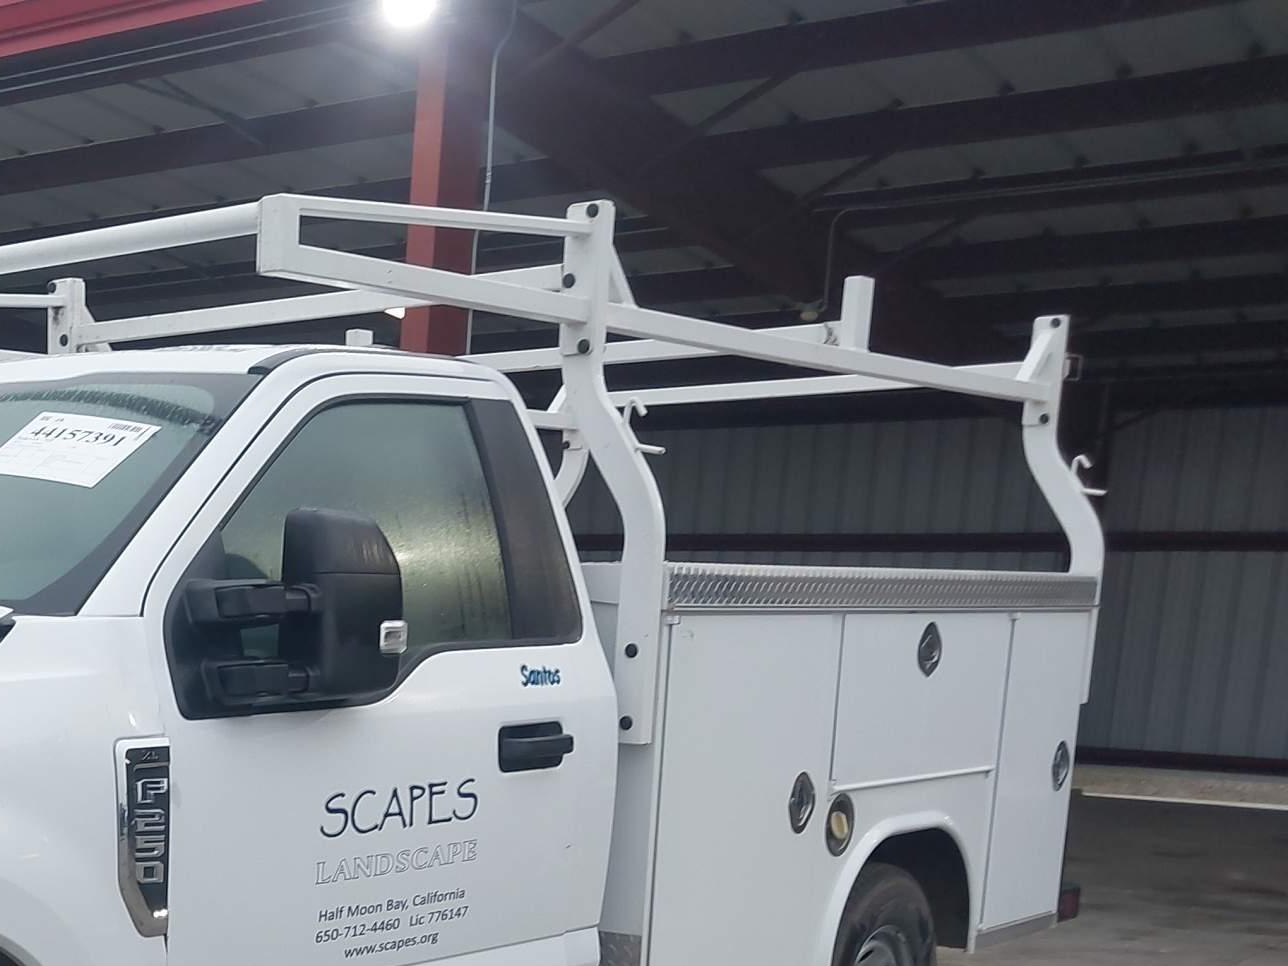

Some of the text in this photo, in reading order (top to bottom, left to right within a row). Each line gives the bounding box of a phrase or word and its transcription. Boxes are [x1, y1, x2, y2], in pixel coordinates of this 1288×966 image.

[30, 425, 127, 447] 44157391
[520, 664, 561, 687] Santos
[319, 778, 479, 838] SCAPES
[314, 838, 479, 886] LANDSCAPE
[318, 888, 466, 923] Half Moon Bay, California
[314, 905, 470, 945] 650-712-4460 Lic 776147
[343, 931, 440, 959] www.scapes.org
